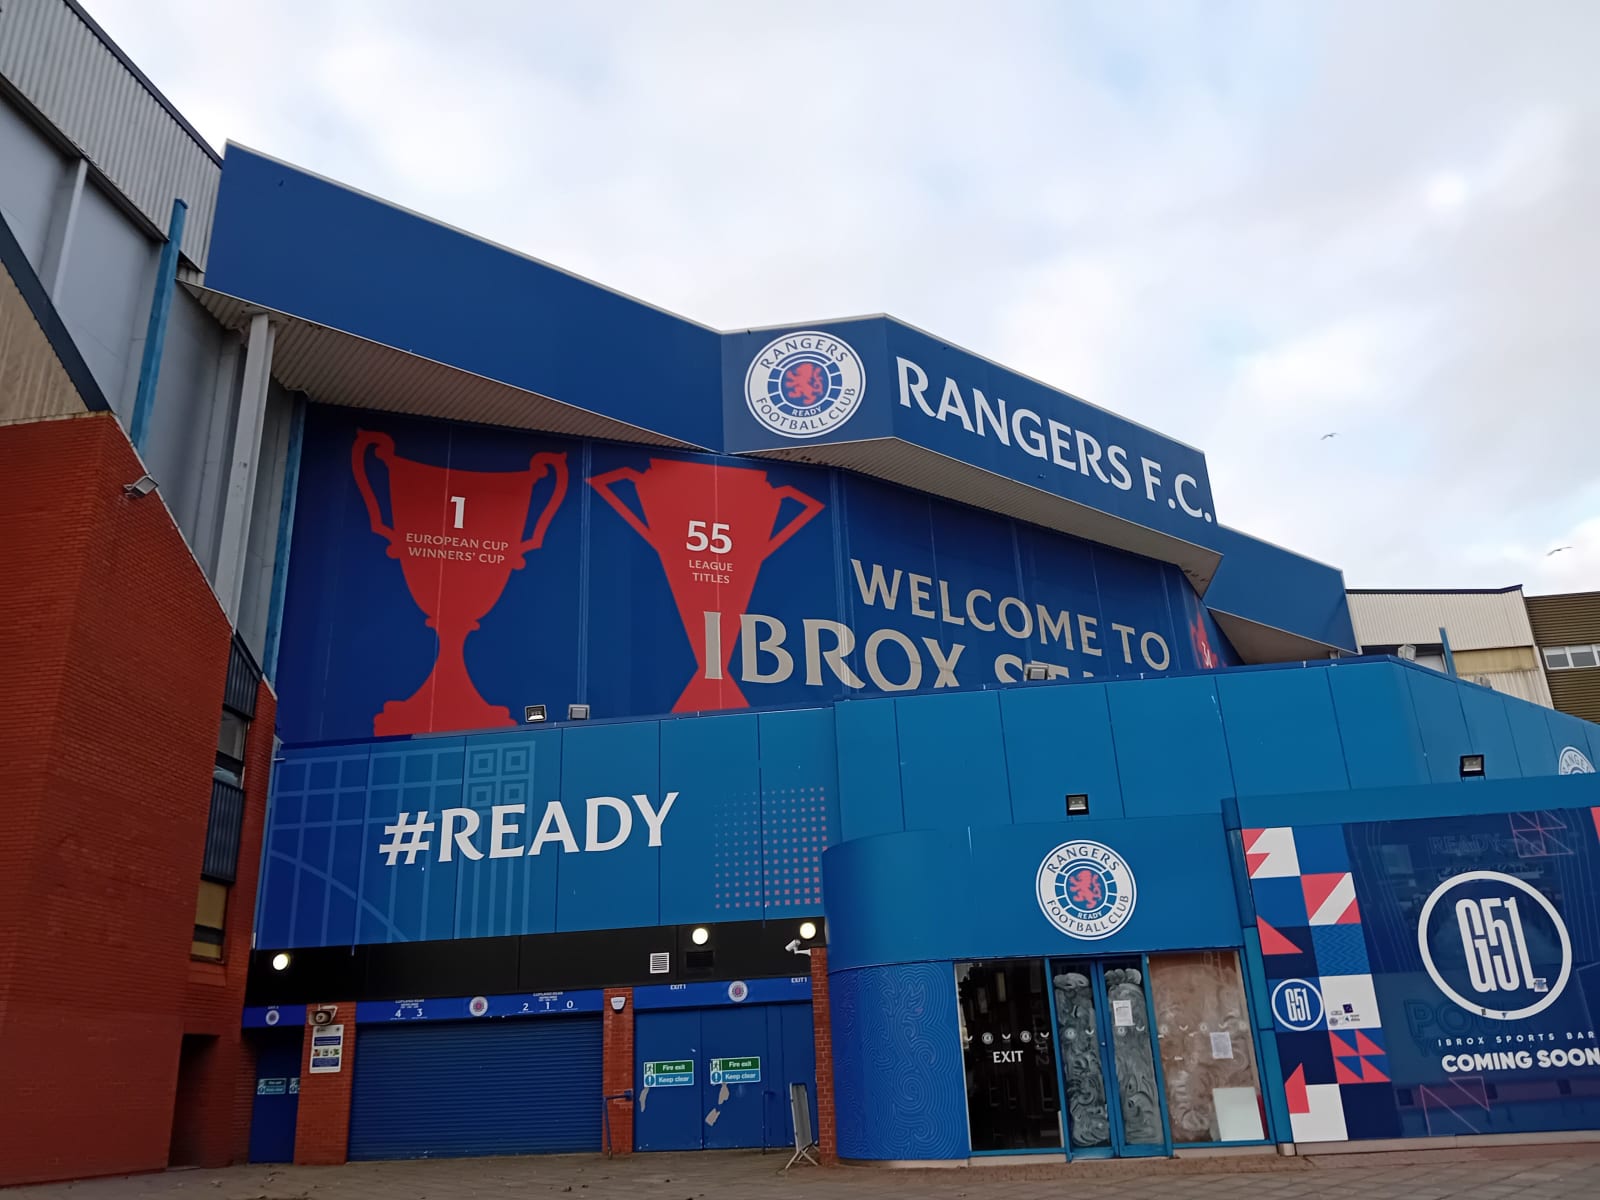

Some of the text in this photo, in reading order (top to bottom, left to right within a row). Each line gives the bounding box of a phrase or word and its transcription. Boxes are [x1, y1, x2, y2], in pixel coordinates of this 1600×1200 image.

[760, 337, 848, 369] RANGERS
[756, 387, 856, 431] FOOTBALL CLUB
[791, 406, 823, 417] READY
[896, 356, 1213, 523] RANGERS F.C.
[450, 495, 466, 529] 1
[405, 532, 509, 551] EUROPEAN CUP
[686, 520, 733, 554] 55
[408, 546, 506, 564] WINNERS' CUP
[688, 559, 734, 572] LEAGUE
[692, 572, 730, 584] TITLES
[850, 558, 1102, 657] WELCOME
[1112, 622, 1170, 671] TO
[703, 611, 967, 692] IBROX
[379, 791, 680, 866] #READY
[1047, 846, 1119, 873] RANGERS
[1047, 895, 1129, 933] FOOTBALL CLUB
[1077, 910, 1102, 920] READY
[1455, 896, 1537, 993] G51
[522, 1002, 530, 1011] 2
[1284, 987, 1312, 1022] G51
[1437, 1036, 1485, 1047] IBROX
[1496, 1033, 1555, 1044] SPORTS
[1566, 1031, 1595, 1041] BAR
[992, 1050, 1024, 1064] EXIT
[1441, 1047, 1600, 1073] COMING SOON
